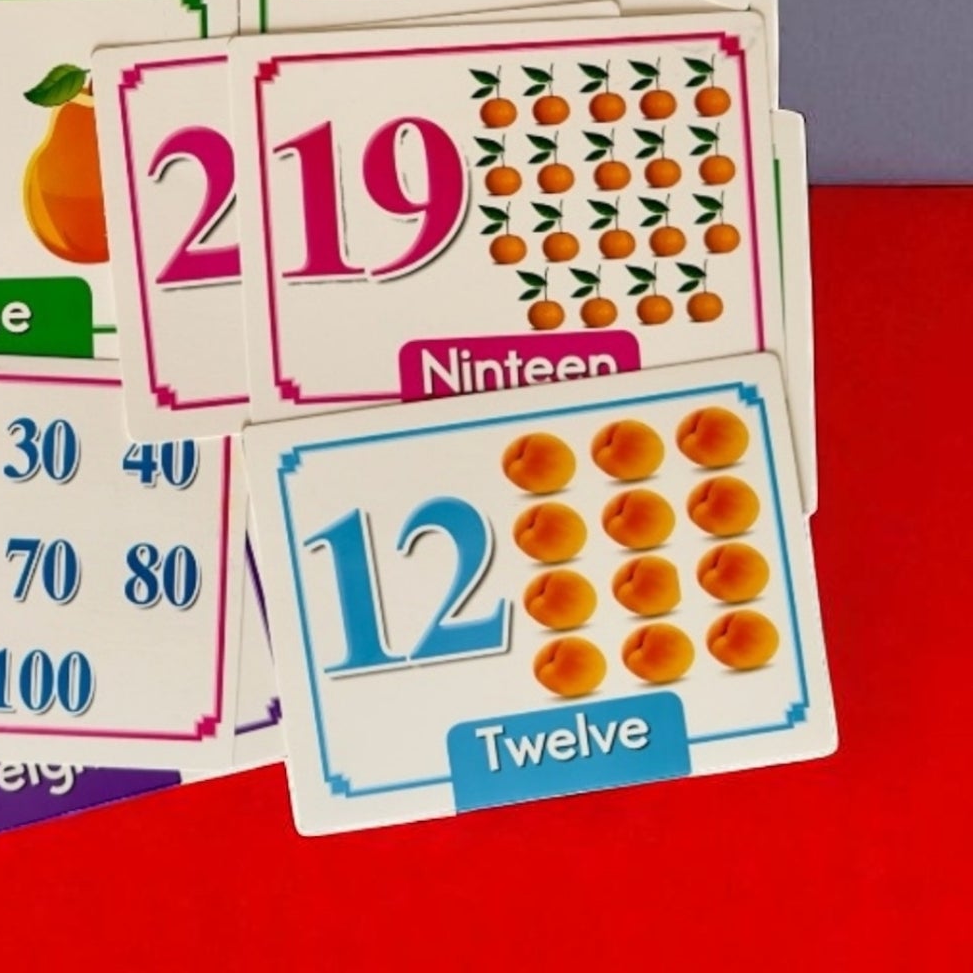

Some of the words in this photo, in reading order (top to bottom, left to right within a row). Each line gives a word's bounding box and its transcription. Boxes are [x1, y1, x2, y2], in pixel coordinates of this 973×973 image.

[272, 116, 473, 284] 19
[422, 346, 618, 394] Ninteen
[2, 417, 79, 483] 30
[122, 438, 199, 489] 40
[5, 538, 82, 604] 70
[124, 543, 201, 610] 80
[303, 495, 513, 679] 12
[475, 713, 649, 773] Twelve
